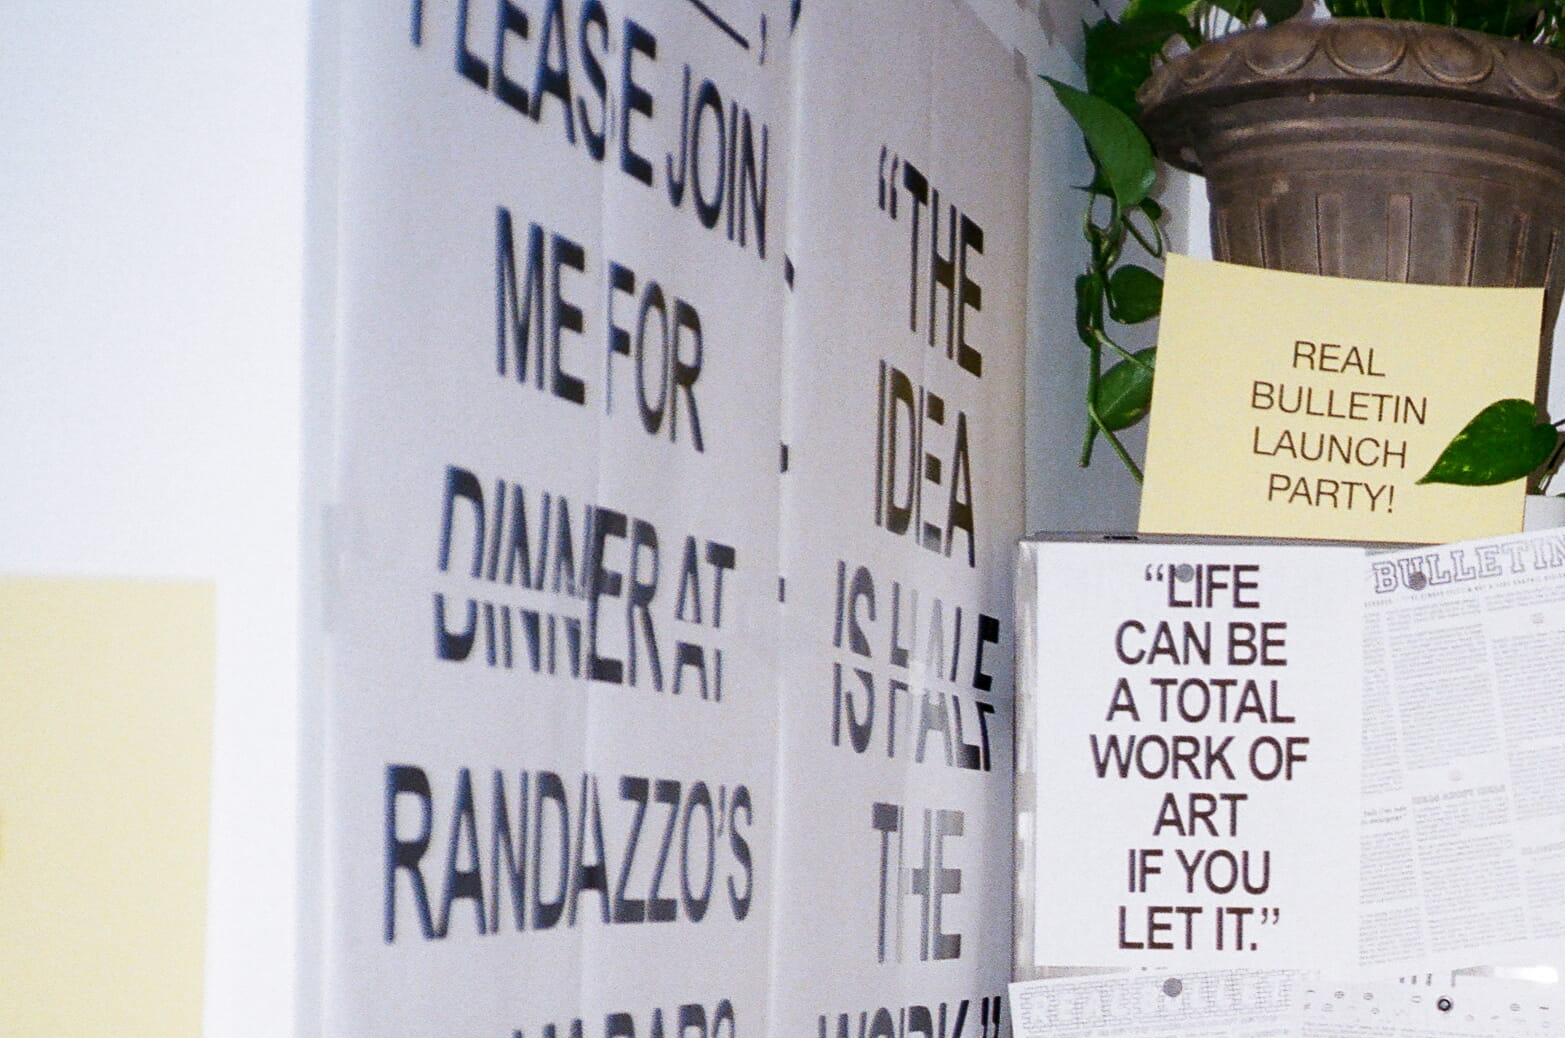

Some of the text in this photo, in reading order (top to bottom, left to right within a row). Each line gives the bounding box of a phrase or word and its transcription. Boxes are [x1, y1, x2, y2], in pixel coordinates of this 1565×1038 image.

[410, 0, 768, 260] LEASE JOIN
[496, 206, 705, 453] ME FOR
[1292, 340, 1387, 378] REAL
[1250, 381, 1428, 425] BULLETIN
[875, 359, 975, 568] IDEA
[1253, 426, 1407, 469] LAUNCH
[1267, 474, 1395, 514] PARTY!
[433, 464, 736, 702] DINNER AT
[831, 558, 876, 755] IS
[1115, 620, 1288, 667] CAN BE
[1106, 677, 1296, 724] A TOTAL
[1090, 734, 1310, 781] WORK OF
[1153, 792, 1248, 837] ART
[872, 802, 964, 963] THE
[1128, 848, 1271, 894] IF YOU
[1118, 905, 1203, 950] LET
